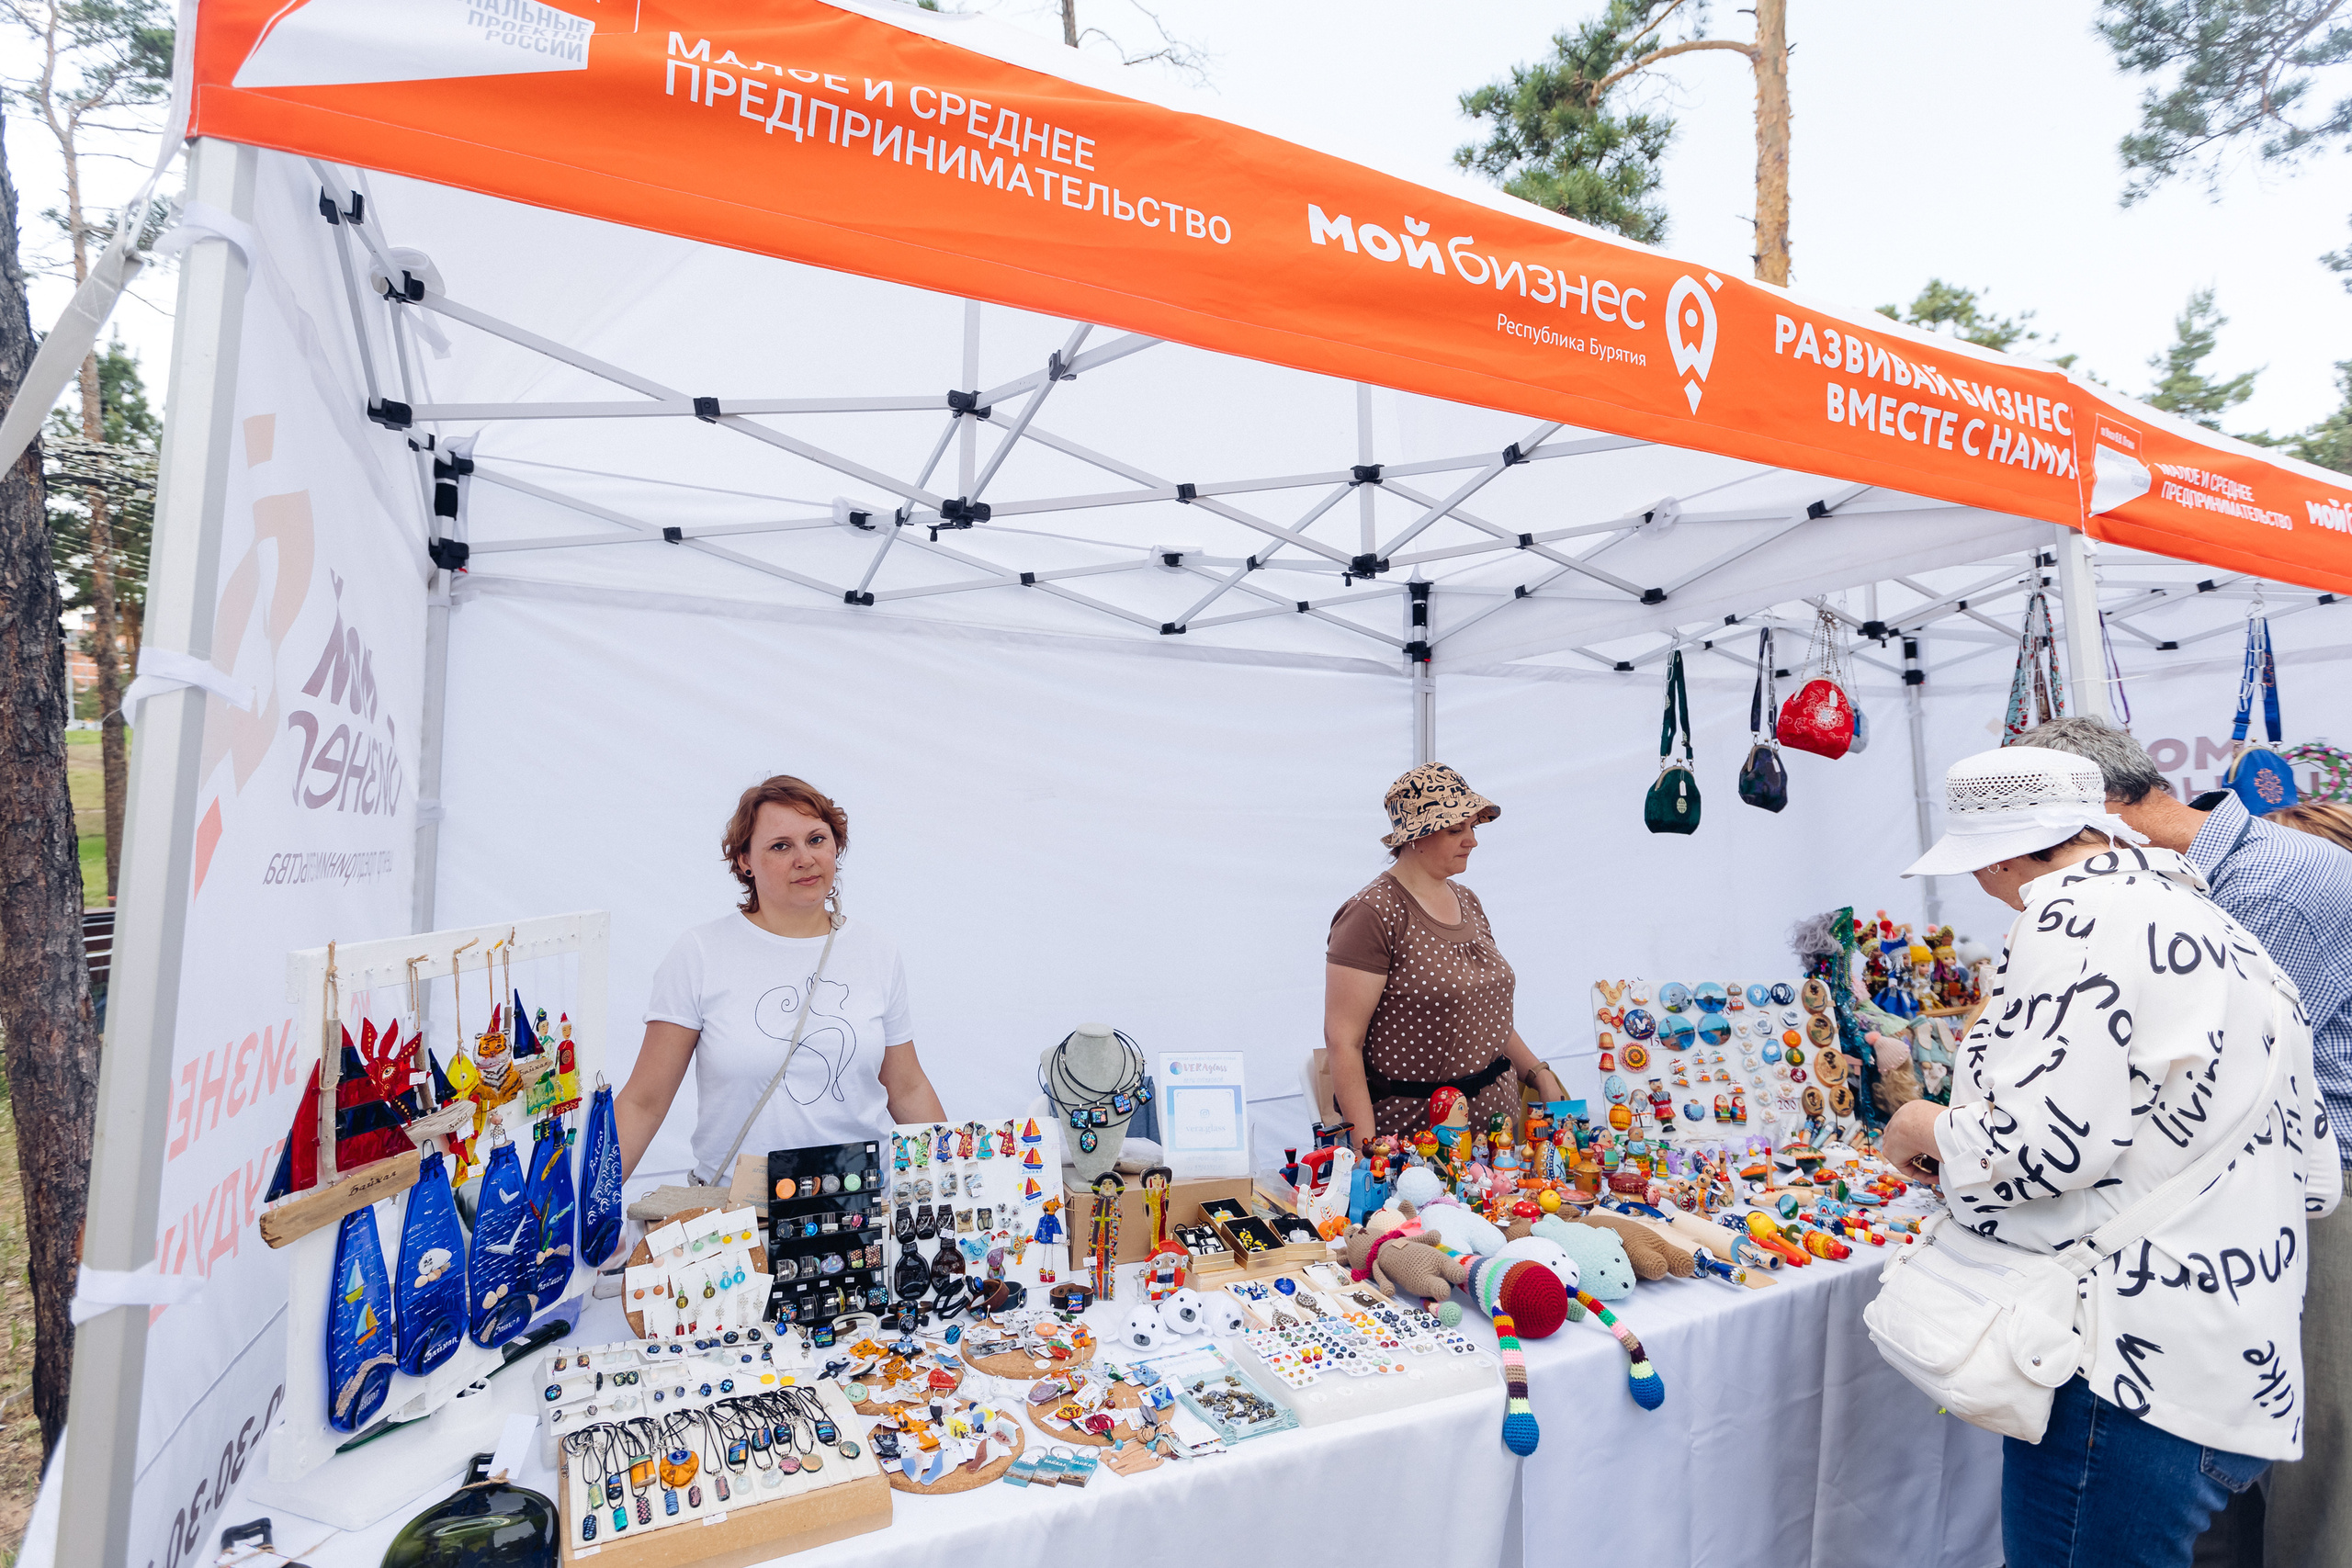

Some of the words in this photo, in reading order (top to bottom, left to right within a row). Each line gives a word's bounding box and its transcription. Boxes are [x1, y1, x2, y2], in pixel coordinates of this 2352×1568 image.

[468, 10, 585, 41] ПРОЕКТЫ
[485, 30, 582, 62] РОССИИ
[667, 31, 850, 94] МАЛОЕ
[864, 77, 895, 108] И
[910, 85, 1096, 172] СРЕДНЕЕ
[665, 58, 1233, 245] ПРЕДПРИНИМАТЕЛЬСТВО
[1497, 312, 1585, 352] Республика
[1589, 337, 1646, 367] Бурятия
[1774, 314, 1959, 400] РАЗВИВАЙ
[1952, 378, 2072, 436] БИЗНЕС
[1826, 382, 1959, 451] ВМЕСТЕ
[1962, 418, 1986, 457] С
[1987, 423, 2075, 479] НАМИ
[2153, 462, 2203, 484] МАЛОЕ
[2201, 472, 2210, 488] И
[2210, 474, 2256, 502] СРЕДНЕЕ
[2162, 481, 2293, 531] ПРЕДПРИНИМАТЕЛЬСТВО
[1185, 1123, 1227, 1135] vera.glass
[1777, 1100, 1797, 1111] 200
